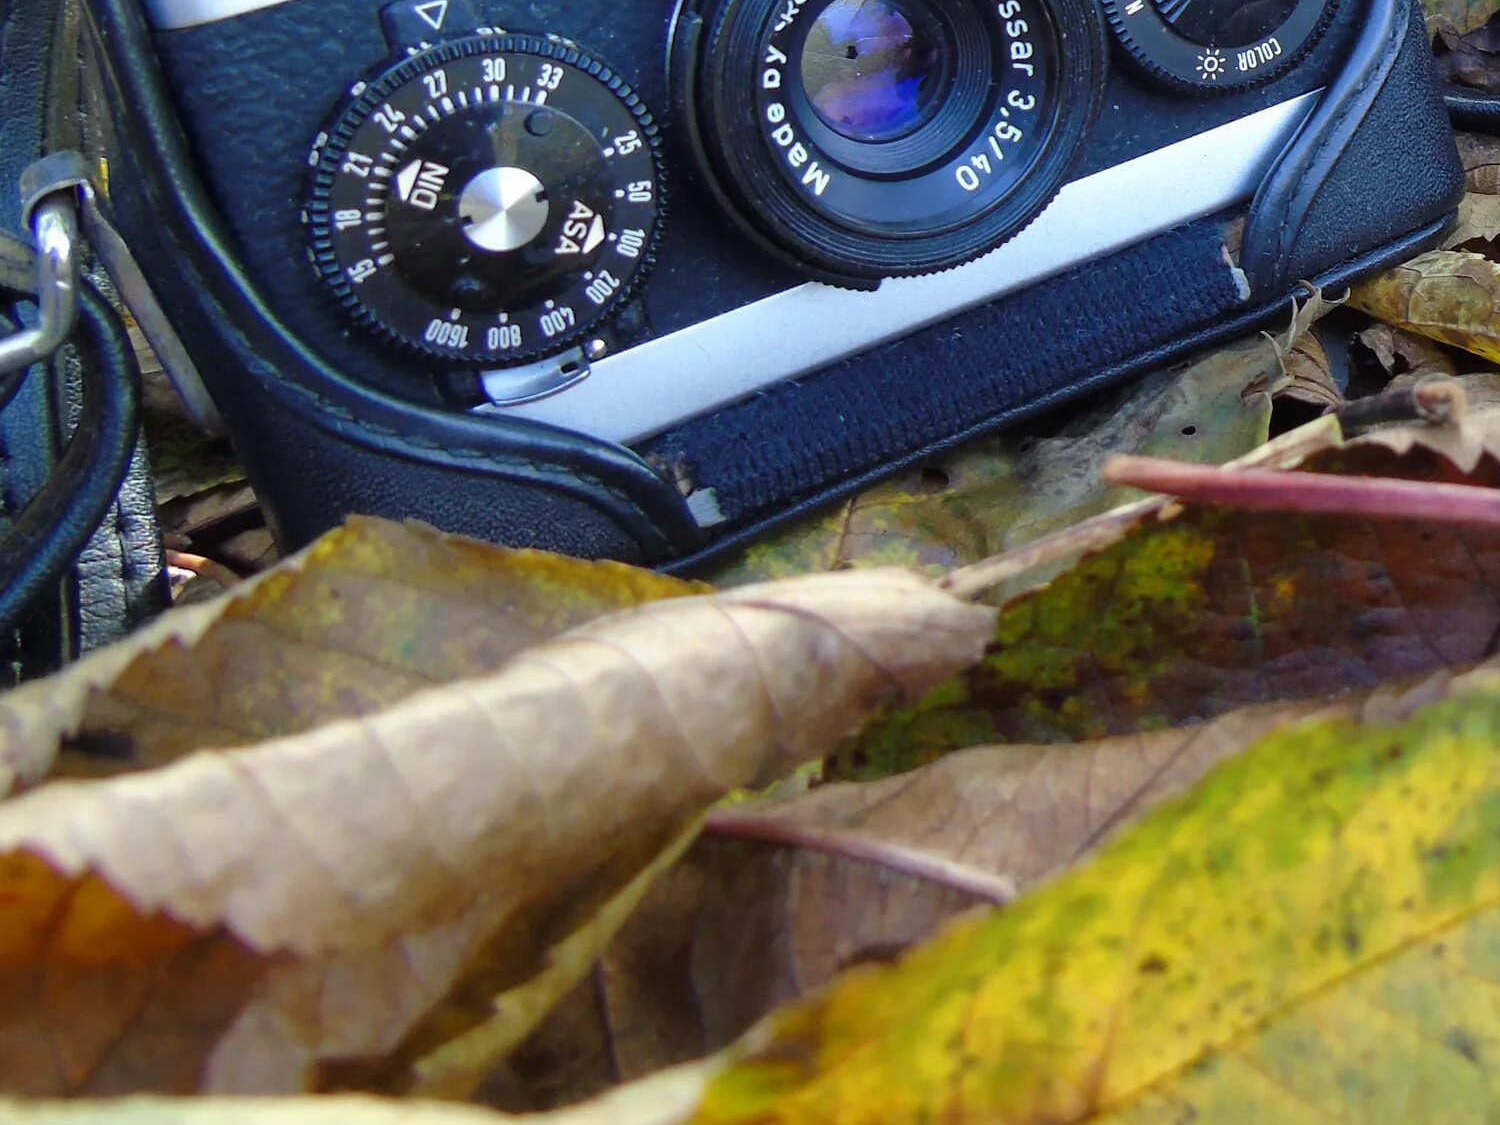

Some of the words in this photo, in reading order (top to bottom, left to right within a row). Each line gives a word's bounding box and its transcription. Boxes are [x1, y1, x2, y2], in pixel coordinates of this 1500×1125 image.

[763, 44, 788, 89] by
[1236, 37, 1283, 72] COLOR
[423, 69, 447, 100] 27
[482, 58, 506, 82] 30
[536, 63, 564, 90] 33
[373, 103, 406, 133] 24
[613, 130, 643, 155] 25
[767, 102, 831, 196] Made
[343, 152, 374, 178] 21
[409, 161, 450, 211] DIN
[627, 180, 652, 203] 50
[335, 209, 362, 230] 18
[554, 200, 594, 255] ASA
[616, 228, 646, 258] 100
[346, 258, 377, 284] 15
[585, 269, 621, 305] 200
[425, 318, 470, 348] 1600
[539, 306, 577, 337] 400
[487, 324, 523, 350] 800
